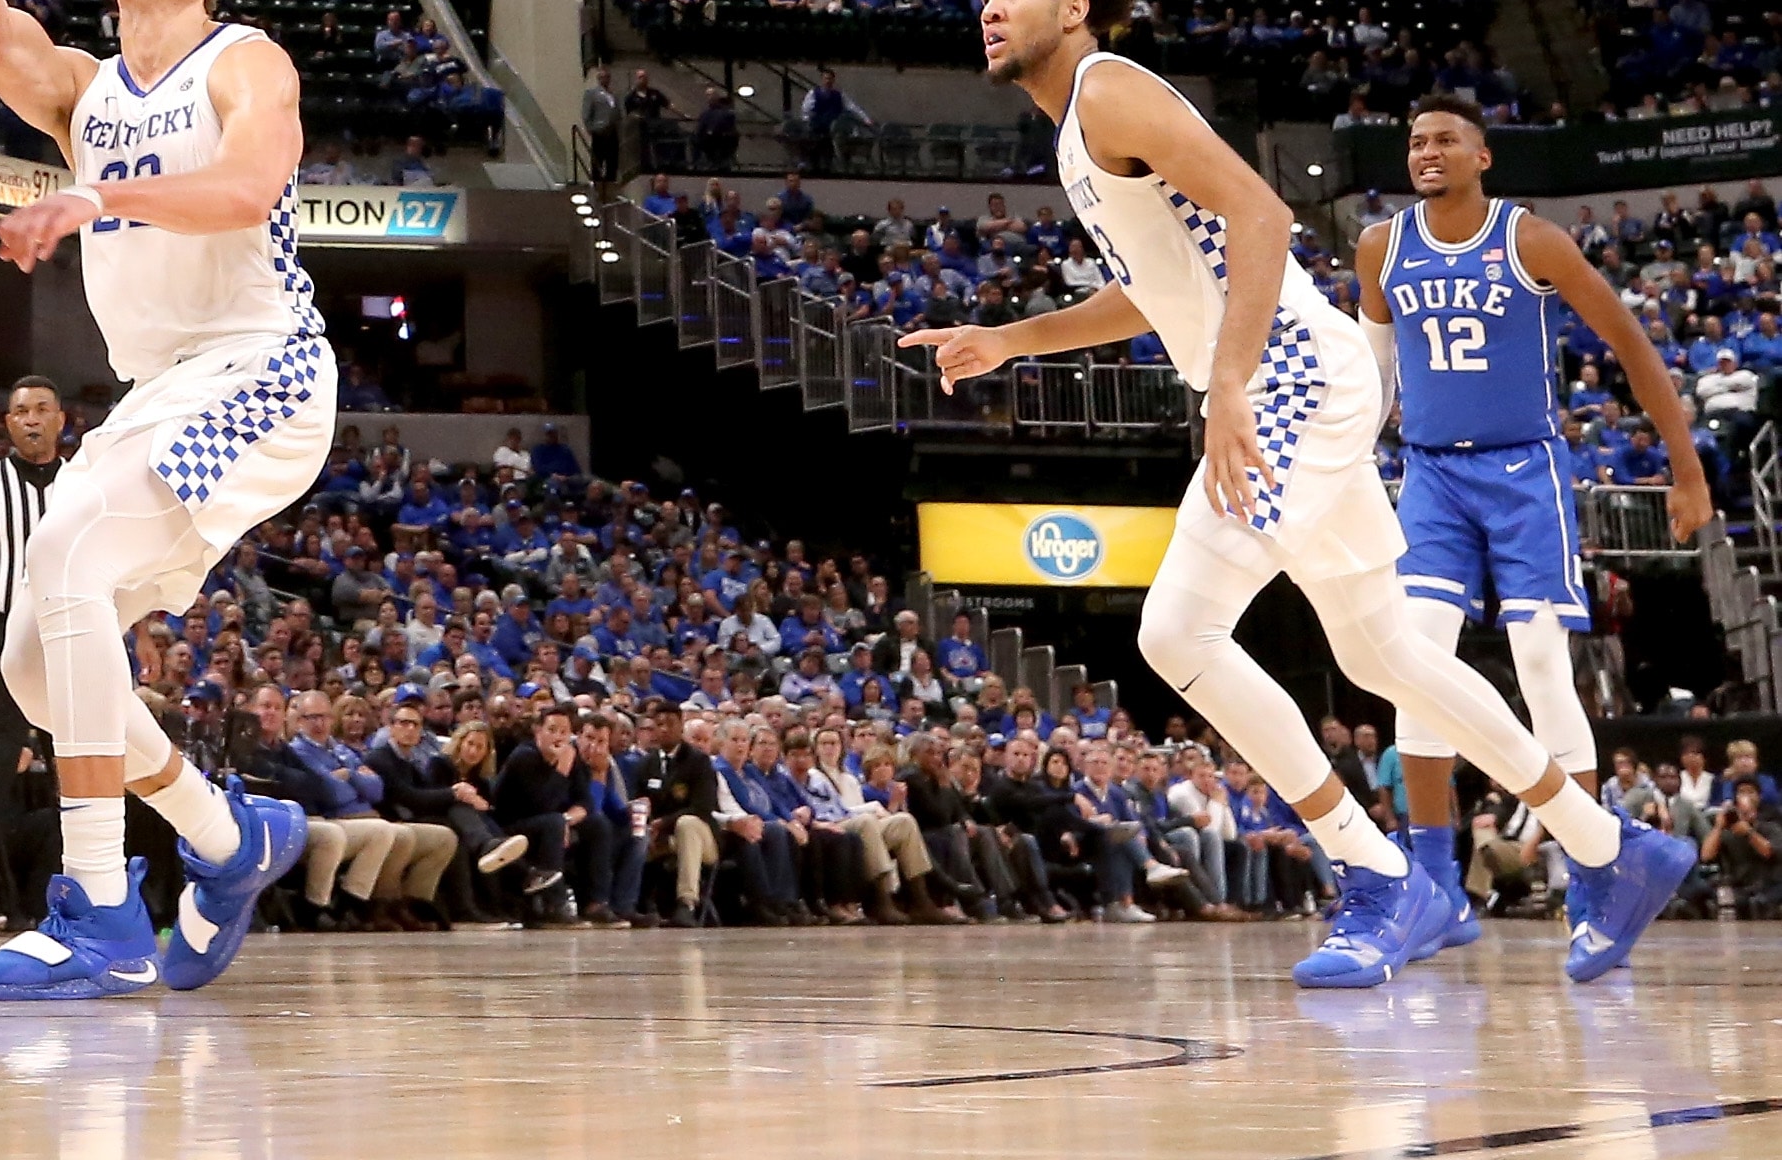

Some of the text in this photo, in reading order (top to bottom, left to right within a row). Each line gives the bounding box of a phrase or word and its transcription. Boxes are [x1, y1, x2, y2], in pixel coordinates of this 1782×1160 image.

[1662, 119, 1773, 144] NEED HELP?
[299, 199, 386, 227] TION
[395, 200, 446, 229] 127
[1392, 278, 1514, 317] DUKE
[1421, 316, 1489, 372] 12
[1030, 522, 1098, 574] Kroger
